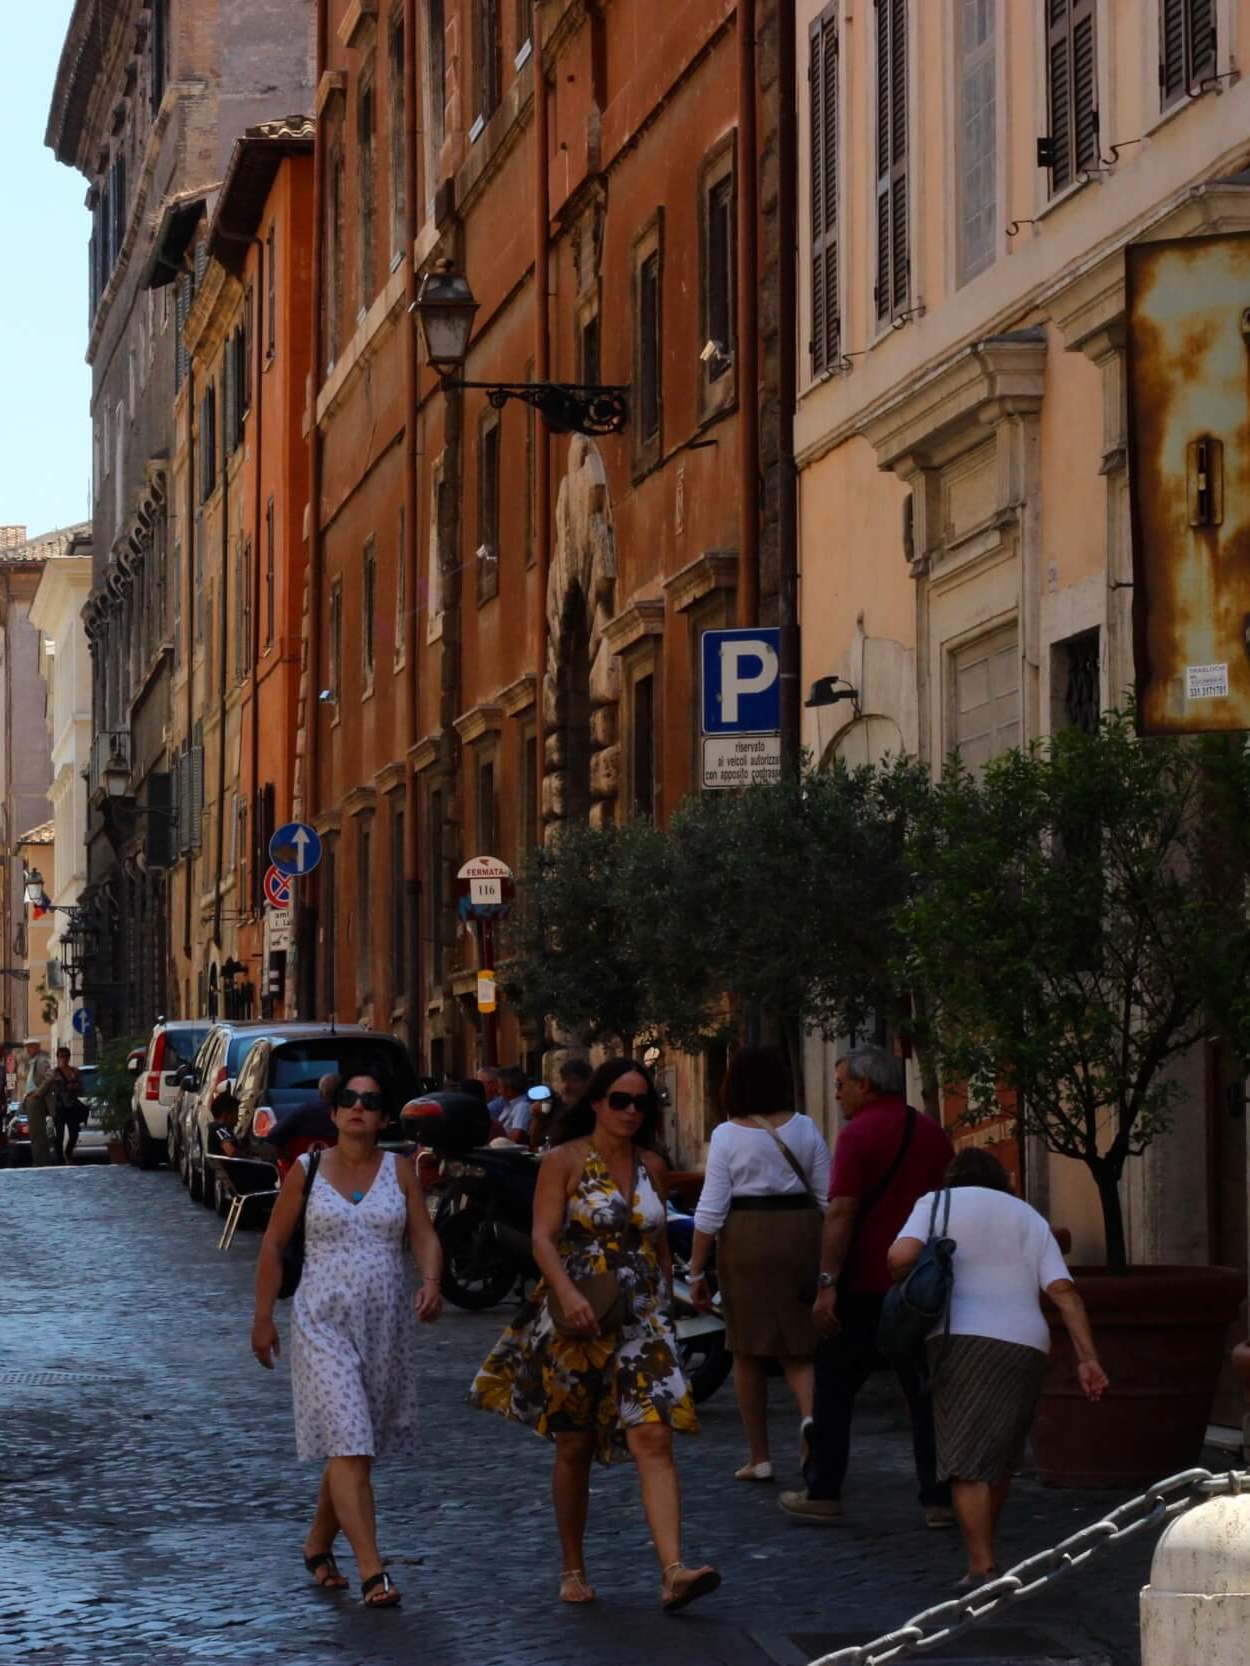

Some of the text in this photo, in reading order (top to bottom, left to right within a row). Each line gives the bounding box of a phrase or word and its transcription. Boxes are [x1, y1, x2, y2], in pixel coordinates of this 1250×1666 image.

[720, 640, 779, 723] P
[735, 741, 765, 753] riservato
[727, 754, 748, 767] veicoli
[705, 771, 717, 780] con
[720, 769, 748, 782] apposito
[467, 868, 503, 876] FERMATA
[479, 885, 495, 896] 116
